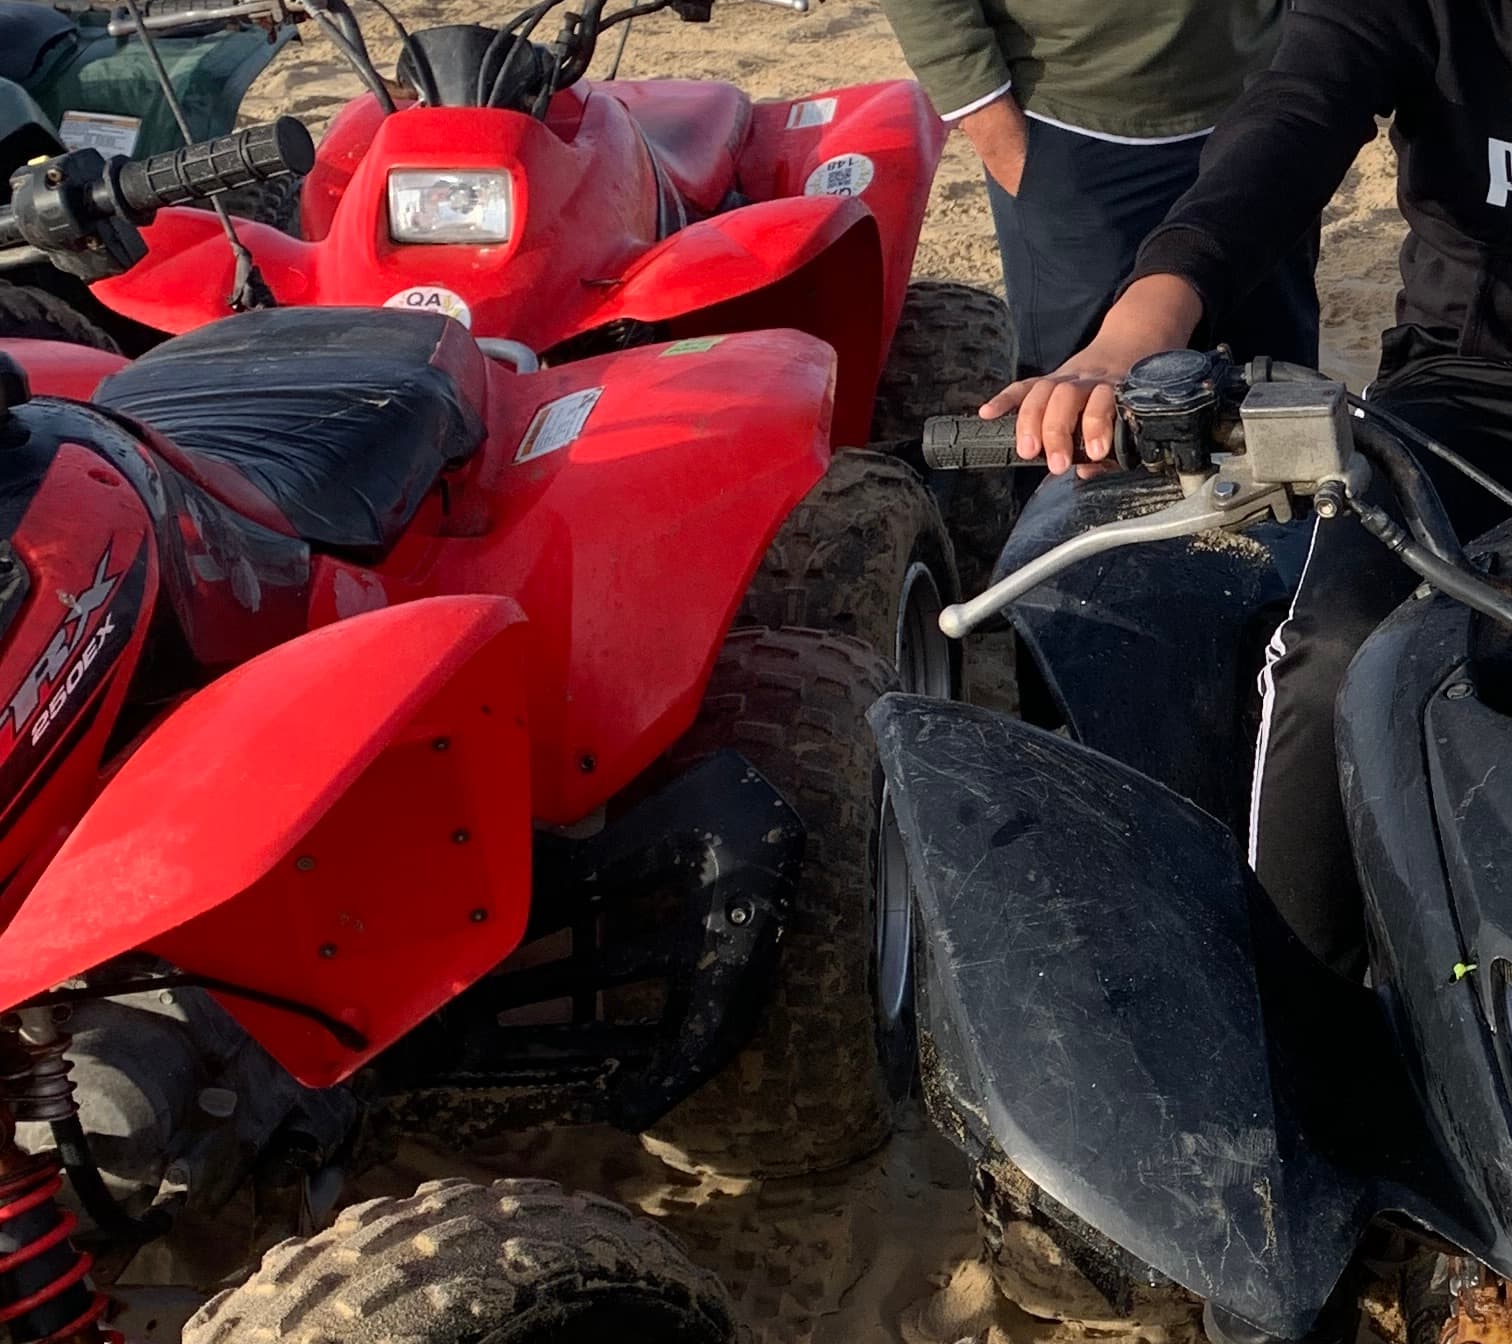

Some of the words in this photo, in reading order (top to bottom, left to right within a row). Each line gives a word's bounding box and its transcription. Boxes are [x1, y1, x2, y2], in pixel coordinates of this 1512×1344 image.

[406, 292, 441, 307] QA
[0, 550, 118, 732] RX
[32, 611, 116, 746] 250EX
